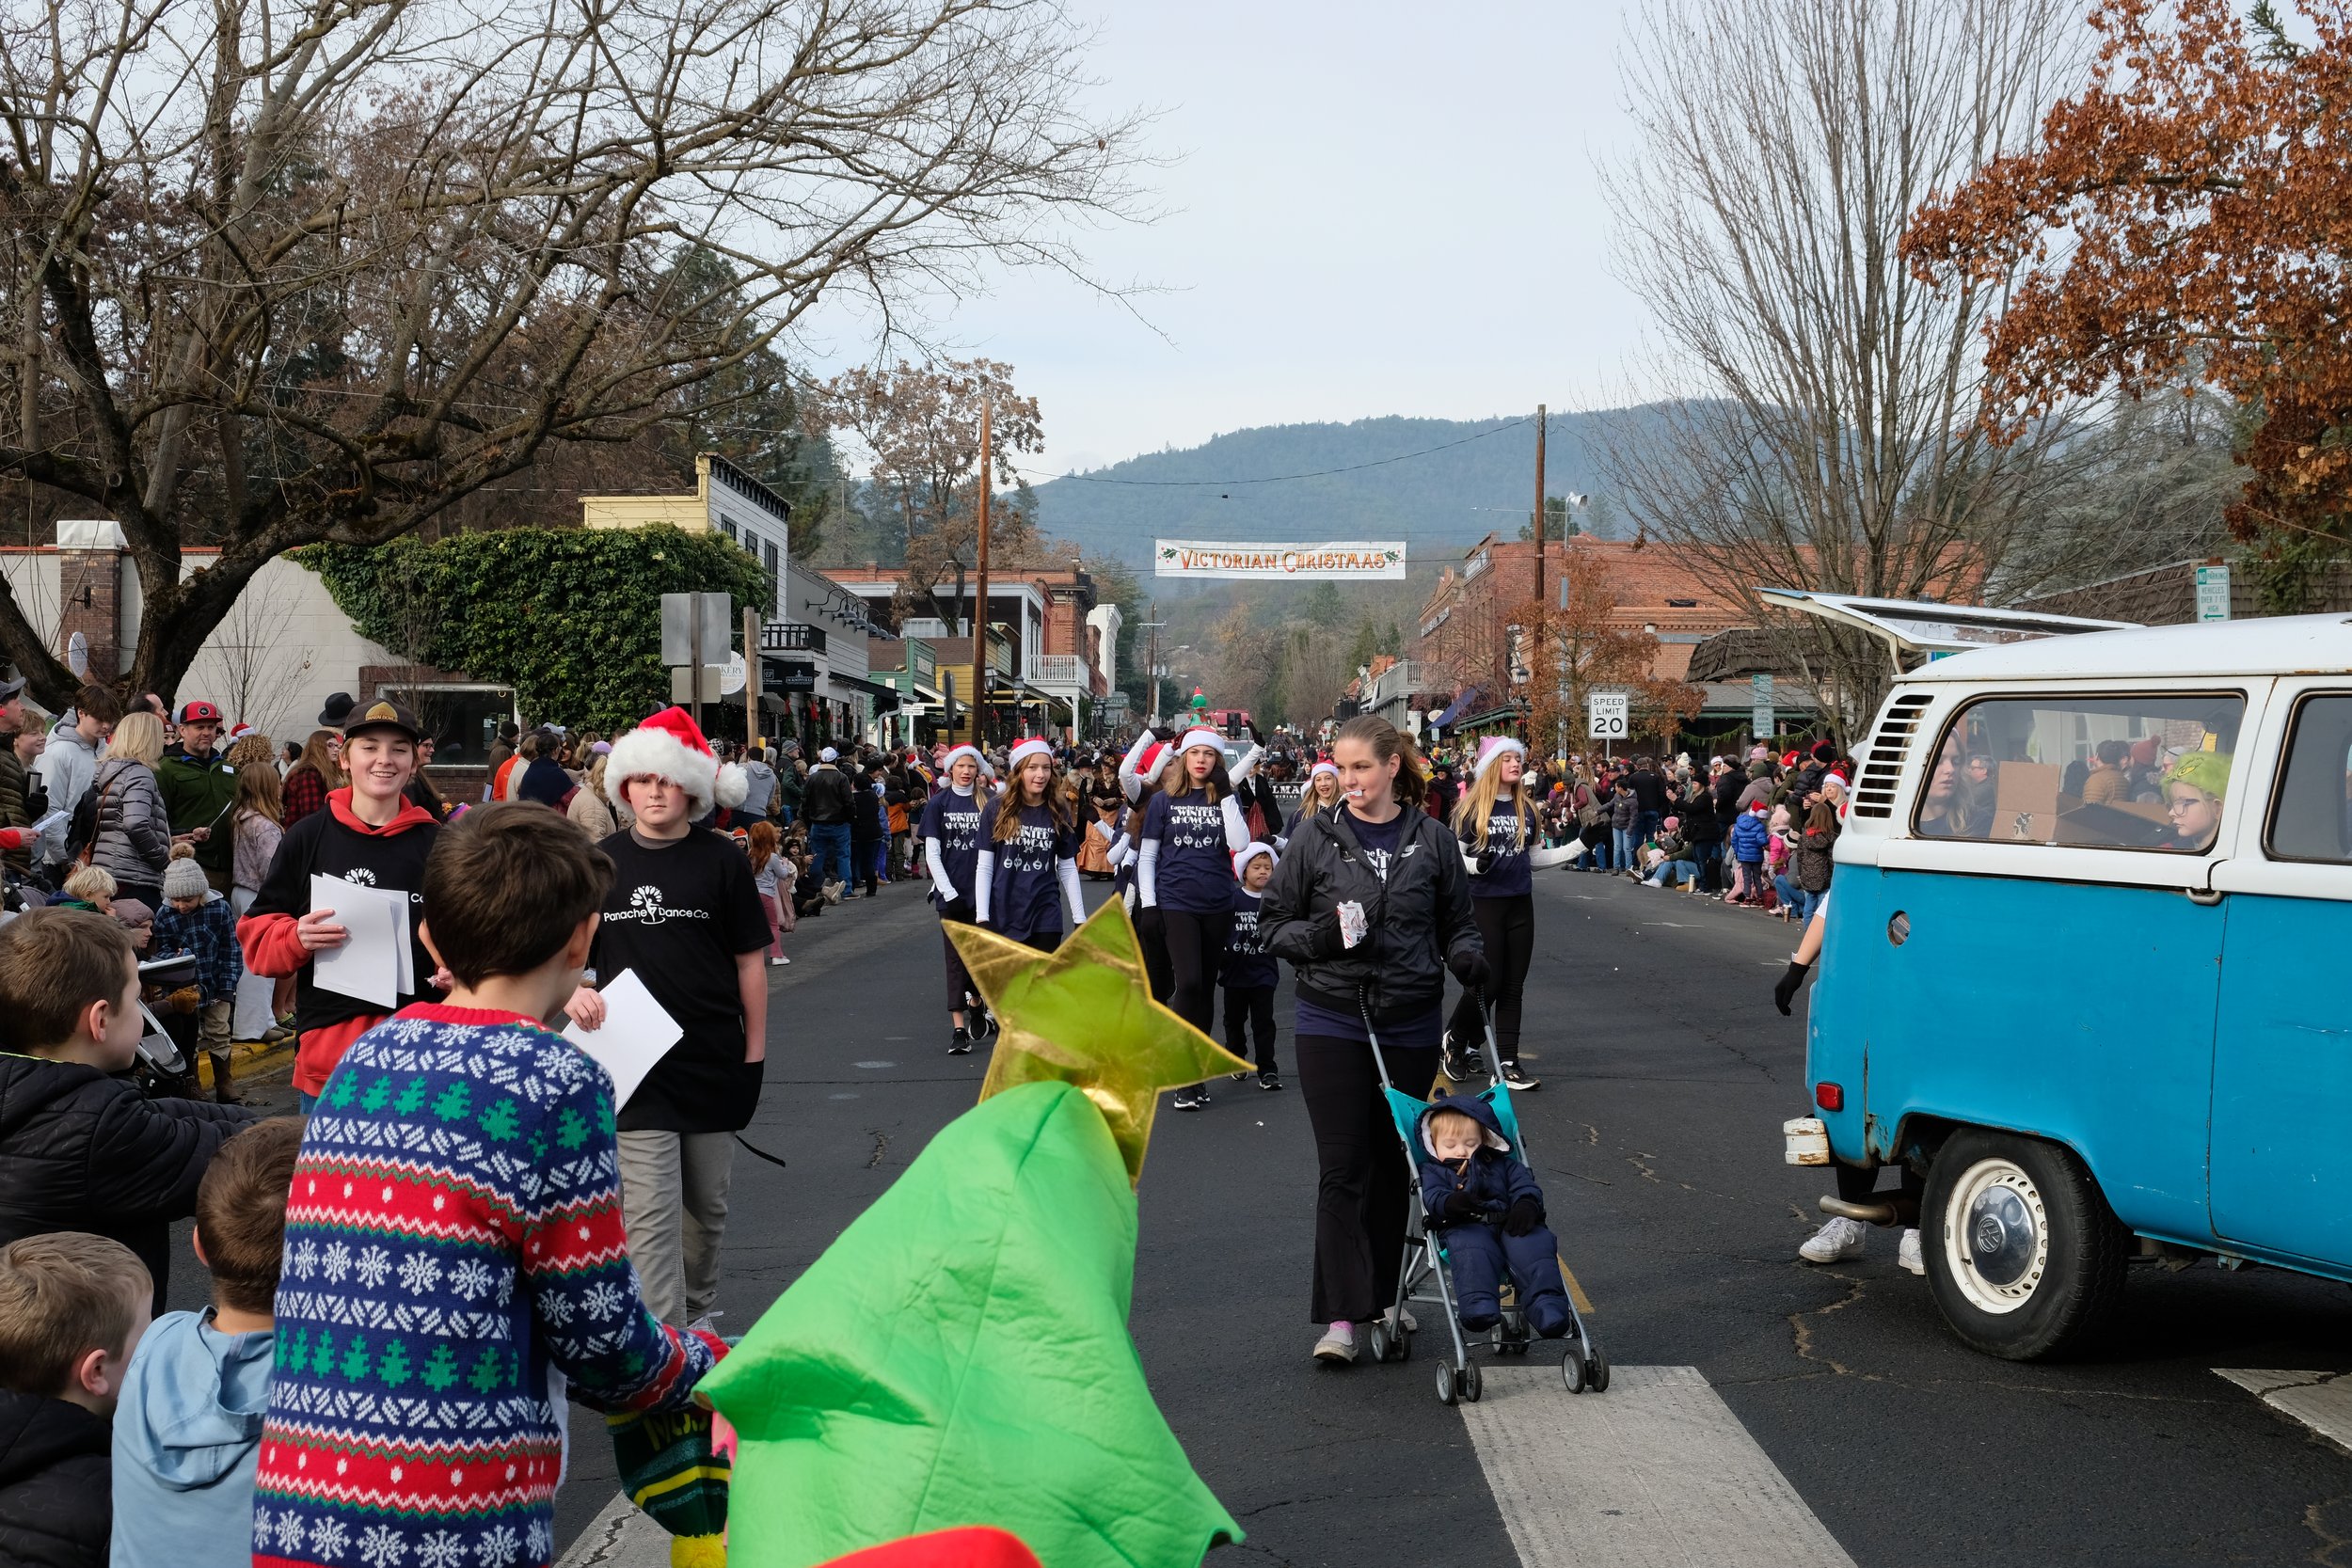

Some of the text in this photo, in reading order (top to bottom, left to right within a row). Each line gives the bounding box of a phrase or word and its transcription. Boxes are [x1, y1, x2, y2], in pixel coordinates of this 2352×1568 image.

[1180, 549, 1386, 573] VICTORIAN CHRISTMAS
[2207, 572, 2228, 580] PARKING
[2202, 586, 2224, 594] VEHICLES
[2201, 595, 2212, 604] OVER
[721, 666, 742, 675] KERY
[1594, 718, 1623, 733] 20
[1170, 816, 1222, 825] SHOWCASE
[1021, 829, 1050, 840] INTER
[1004, 837, 1054, 848] SHOWCASE
[603, 907, 710, 922] Panache Dance Co.
[1235, 923, 1258, 931] SHOW
